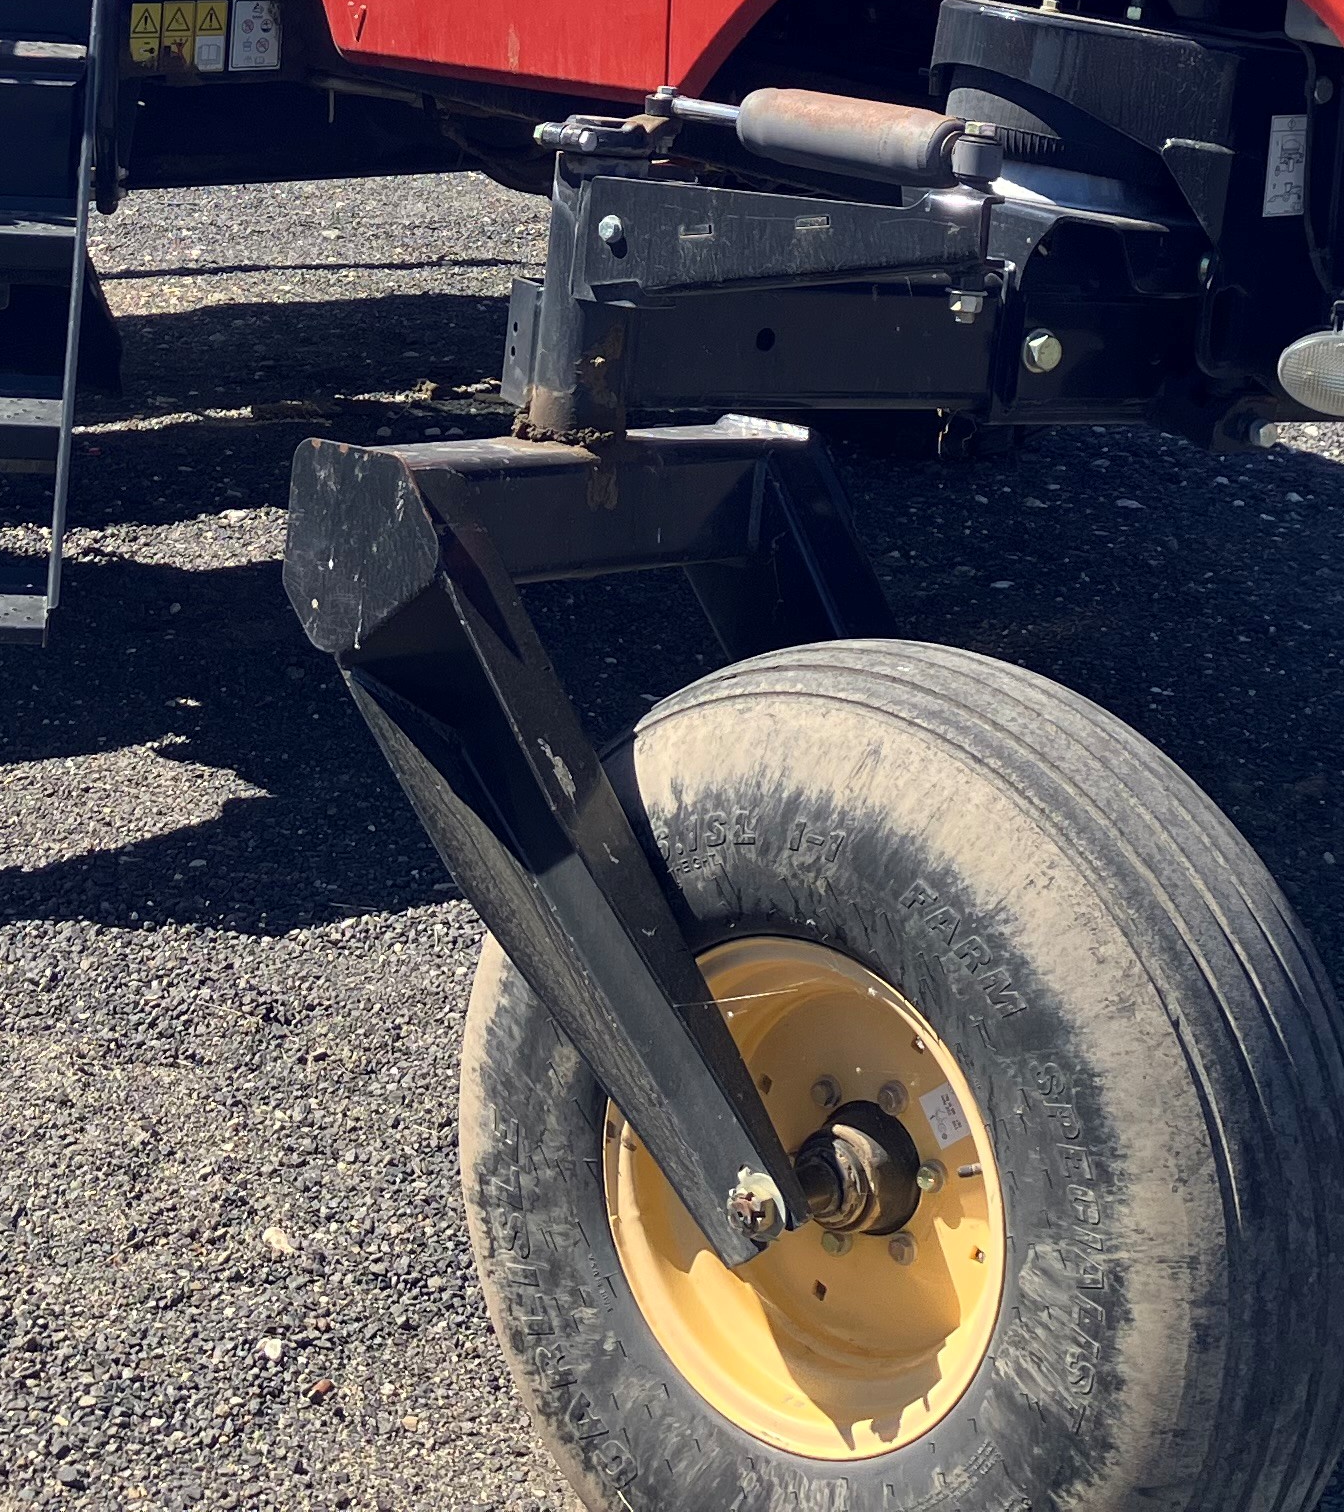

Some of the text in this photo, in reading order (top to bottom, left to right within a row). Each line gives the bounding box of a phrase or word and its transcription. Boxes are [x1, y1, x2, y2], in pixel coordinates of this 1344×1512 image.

[897, 877, 1029, 1019] FARM
[488, 1103, 640, 1487] CARLISLE
[1029, 1060, 1107, 1436] SPECIALIST
